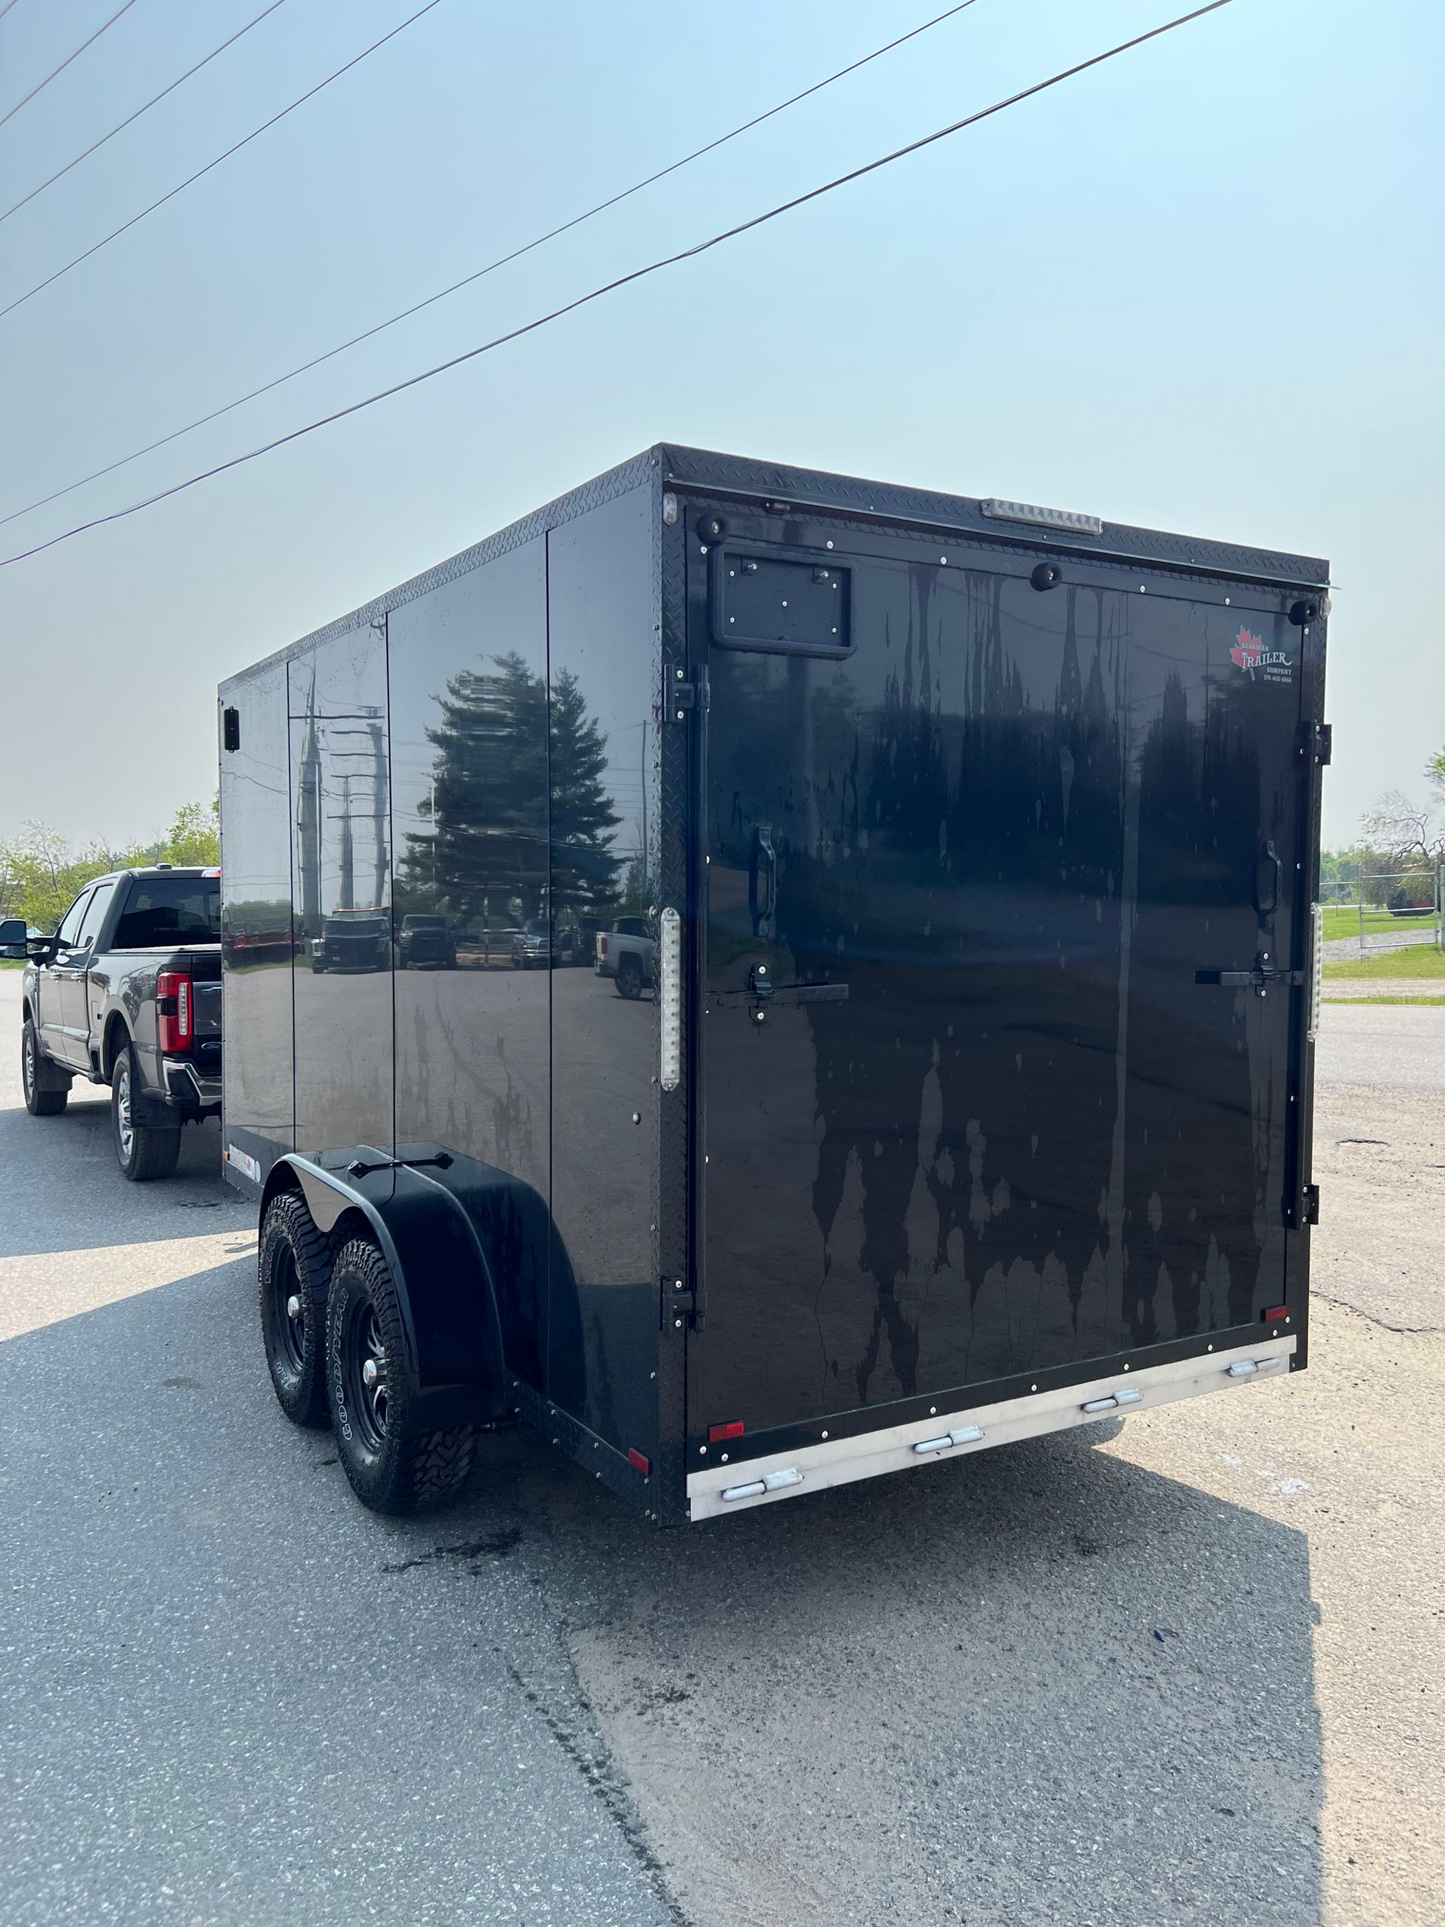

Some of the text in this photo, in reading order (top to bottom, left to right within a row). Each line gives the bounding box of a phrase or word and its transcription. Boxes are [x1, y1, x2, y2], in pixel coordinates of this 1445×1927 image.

[1242, 643, 1269, 651] CANADIAN
[1242, 652, 1292, 669] TRAILER
[1266, 667, 1292, 675] COMPANY
[332, 1287, 353, 1441] GOODYEAR
